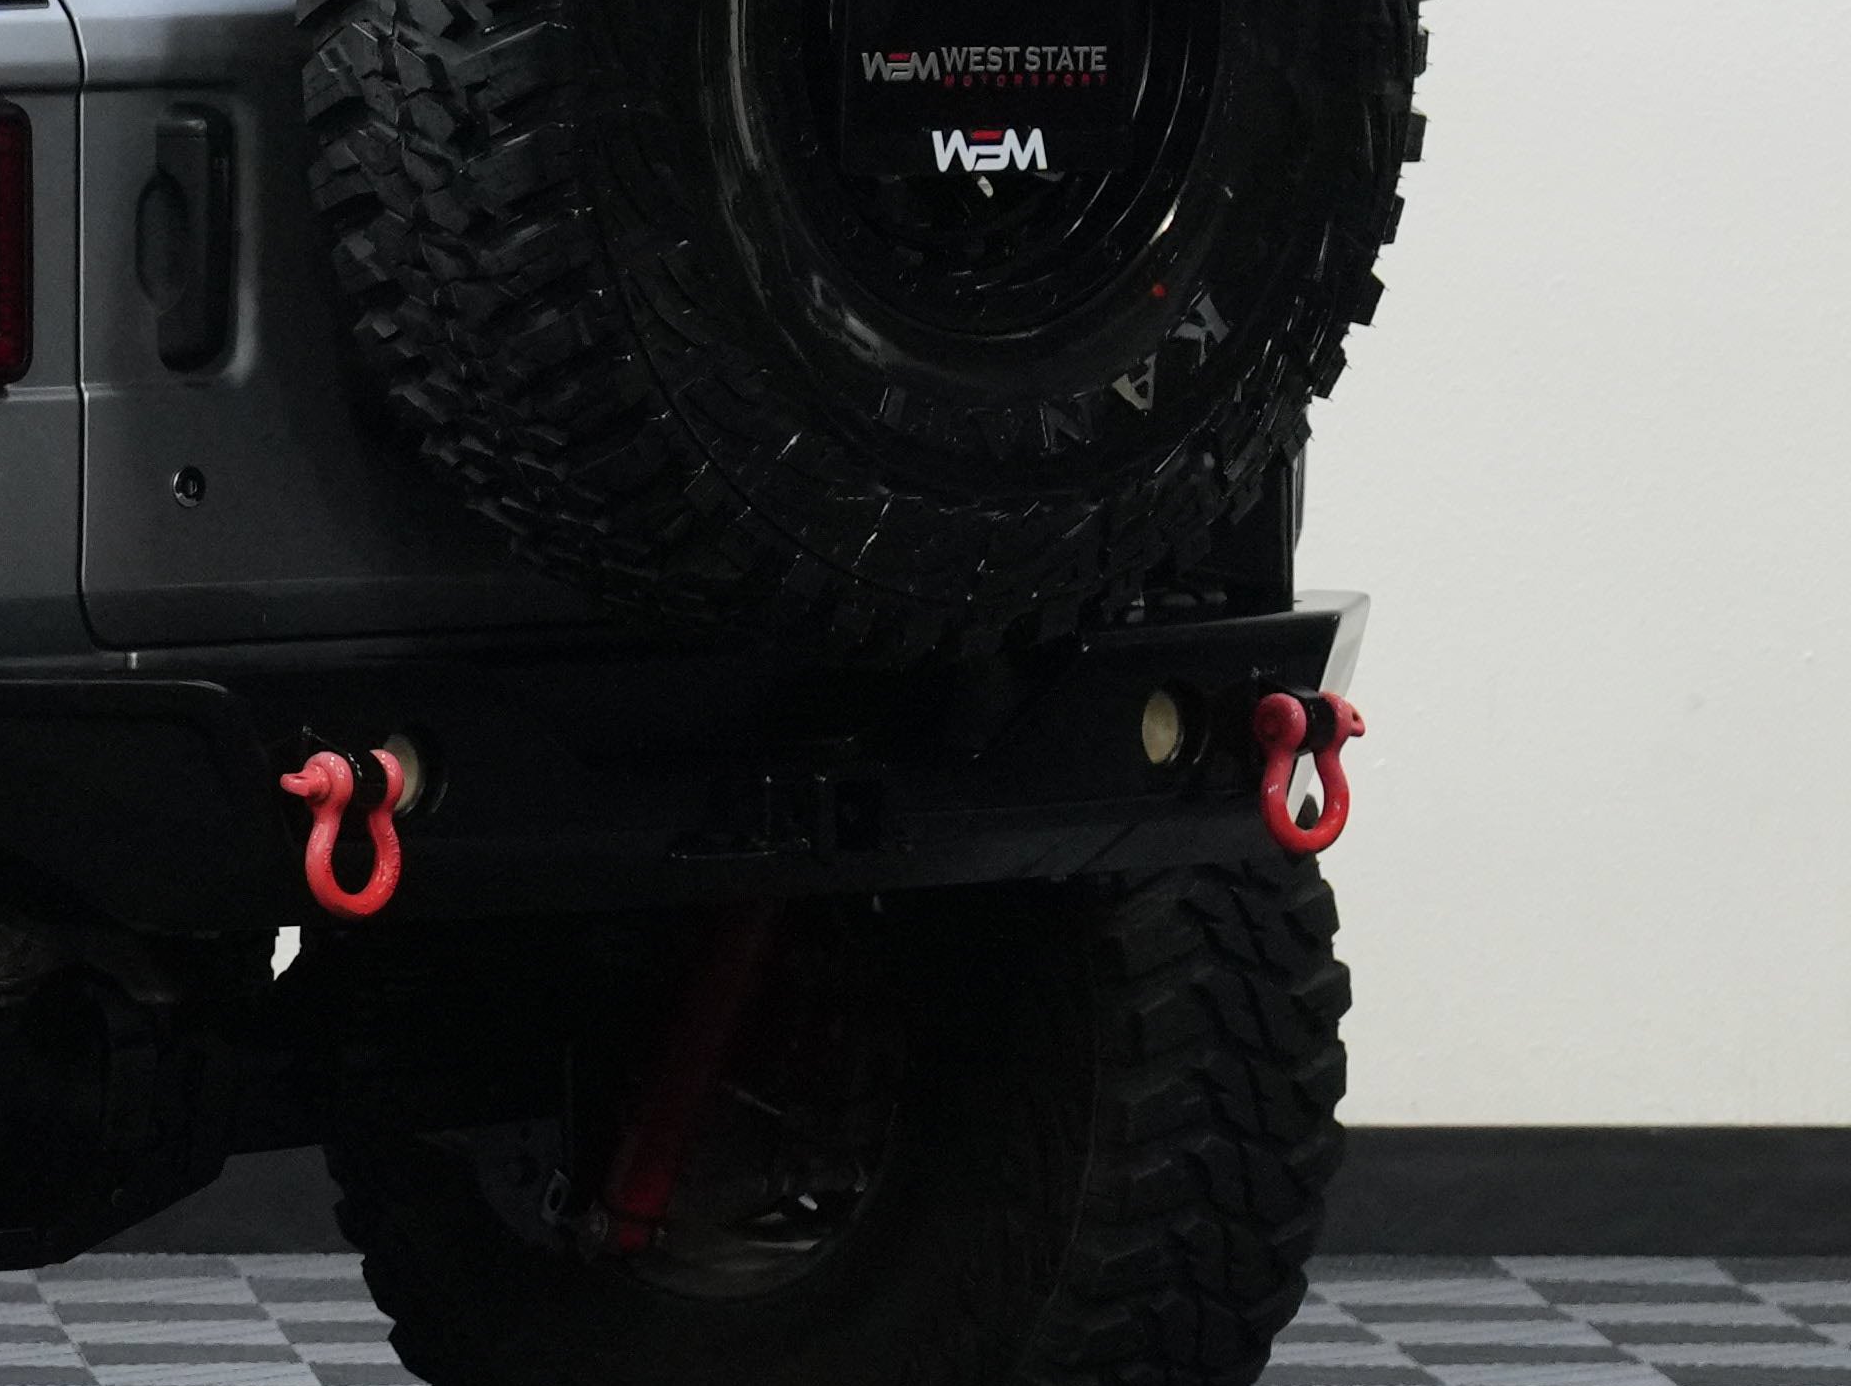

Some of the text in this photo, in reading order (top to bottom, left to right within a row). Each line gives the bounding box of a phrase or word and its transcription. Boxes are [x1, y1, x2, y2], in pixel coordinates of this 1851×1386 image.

[941, 46, 1020, 72] WEST
[1025, 45, 1108, 72] STATE
[942, 73, 1109, 87] MOTORSPORT
[932, 127, 1048, 173] WSM
